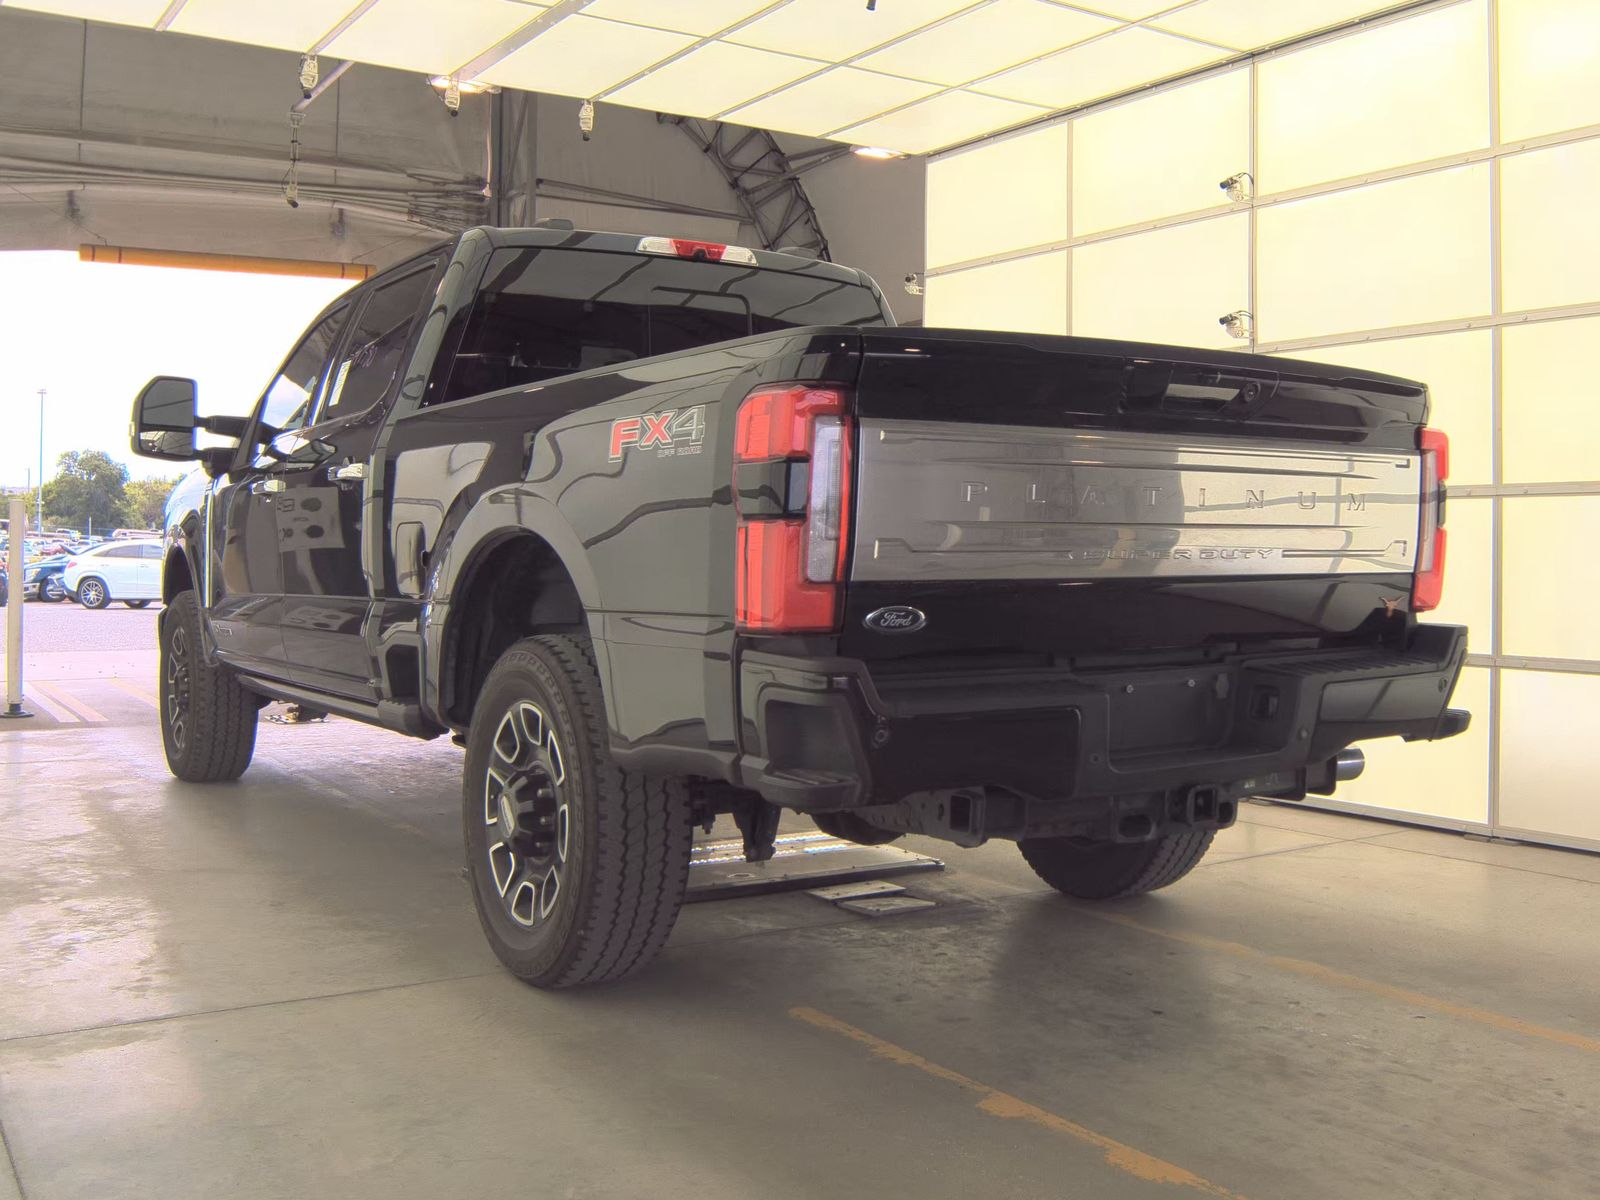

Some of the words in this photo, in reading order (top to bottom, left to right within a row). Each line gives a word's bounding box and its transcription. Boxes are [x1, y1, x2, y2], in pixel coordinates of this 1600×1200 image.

[608, 405, 706, 462] FX4
[960, 481, 1367, 512] PLATINUM
[1199, 548, 1273, 560] DUTY
[880, 611, 913, 627] Ford
